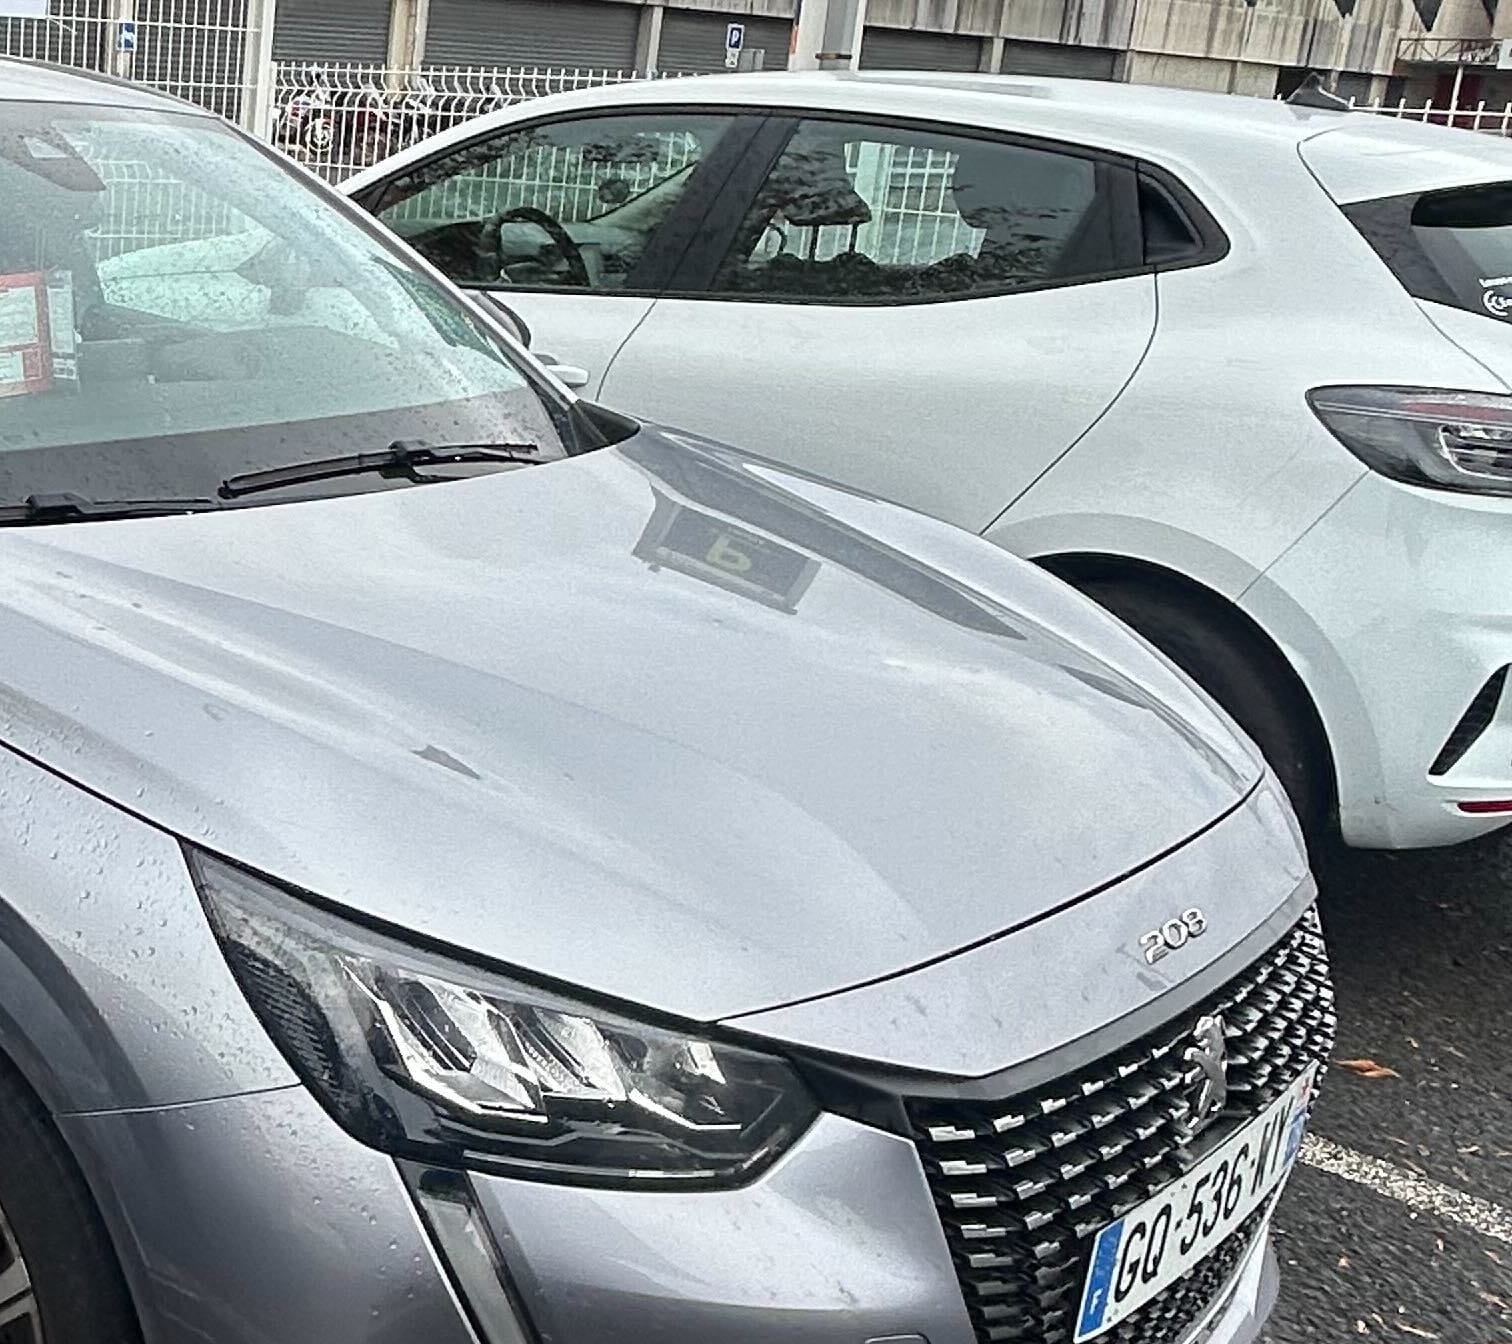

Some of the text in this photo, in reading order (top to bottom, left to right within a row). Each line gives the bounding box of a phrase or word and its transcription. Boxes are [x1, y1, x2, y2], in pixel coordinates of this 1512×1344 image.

[731, 29, 740, 47] P
[1139, 907, 1208, 965] 208
[1090, 1288, 1104, 1315] F
